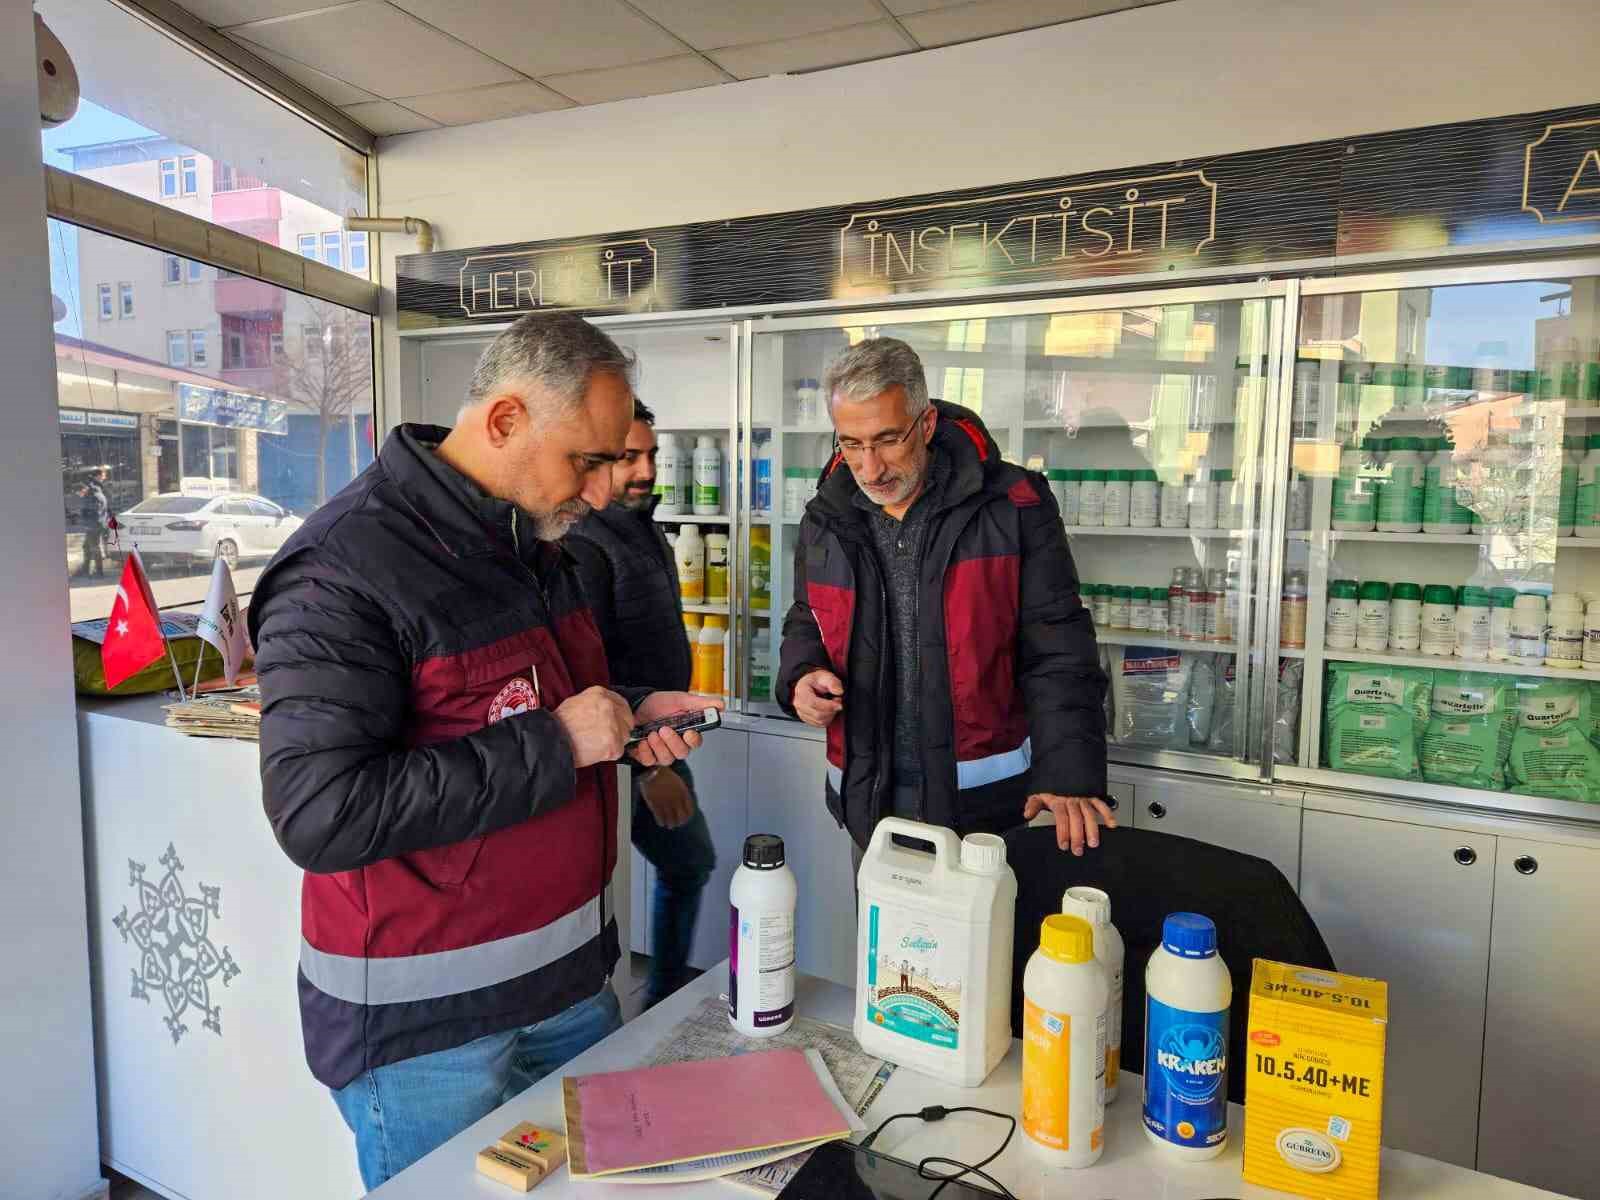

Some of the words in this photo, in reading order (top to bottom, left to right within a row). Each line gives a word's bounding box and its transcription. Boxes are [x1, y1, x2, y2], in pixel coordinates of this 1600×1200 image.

[863, 188, 1186, 276] İNSEKTİSİT
[472, 249, 642, 310] HERİT
[1157, 1048, 1226, 1076] KRAKEN
[1255, 1053, 1371, 1097] 10.5.40+ME
